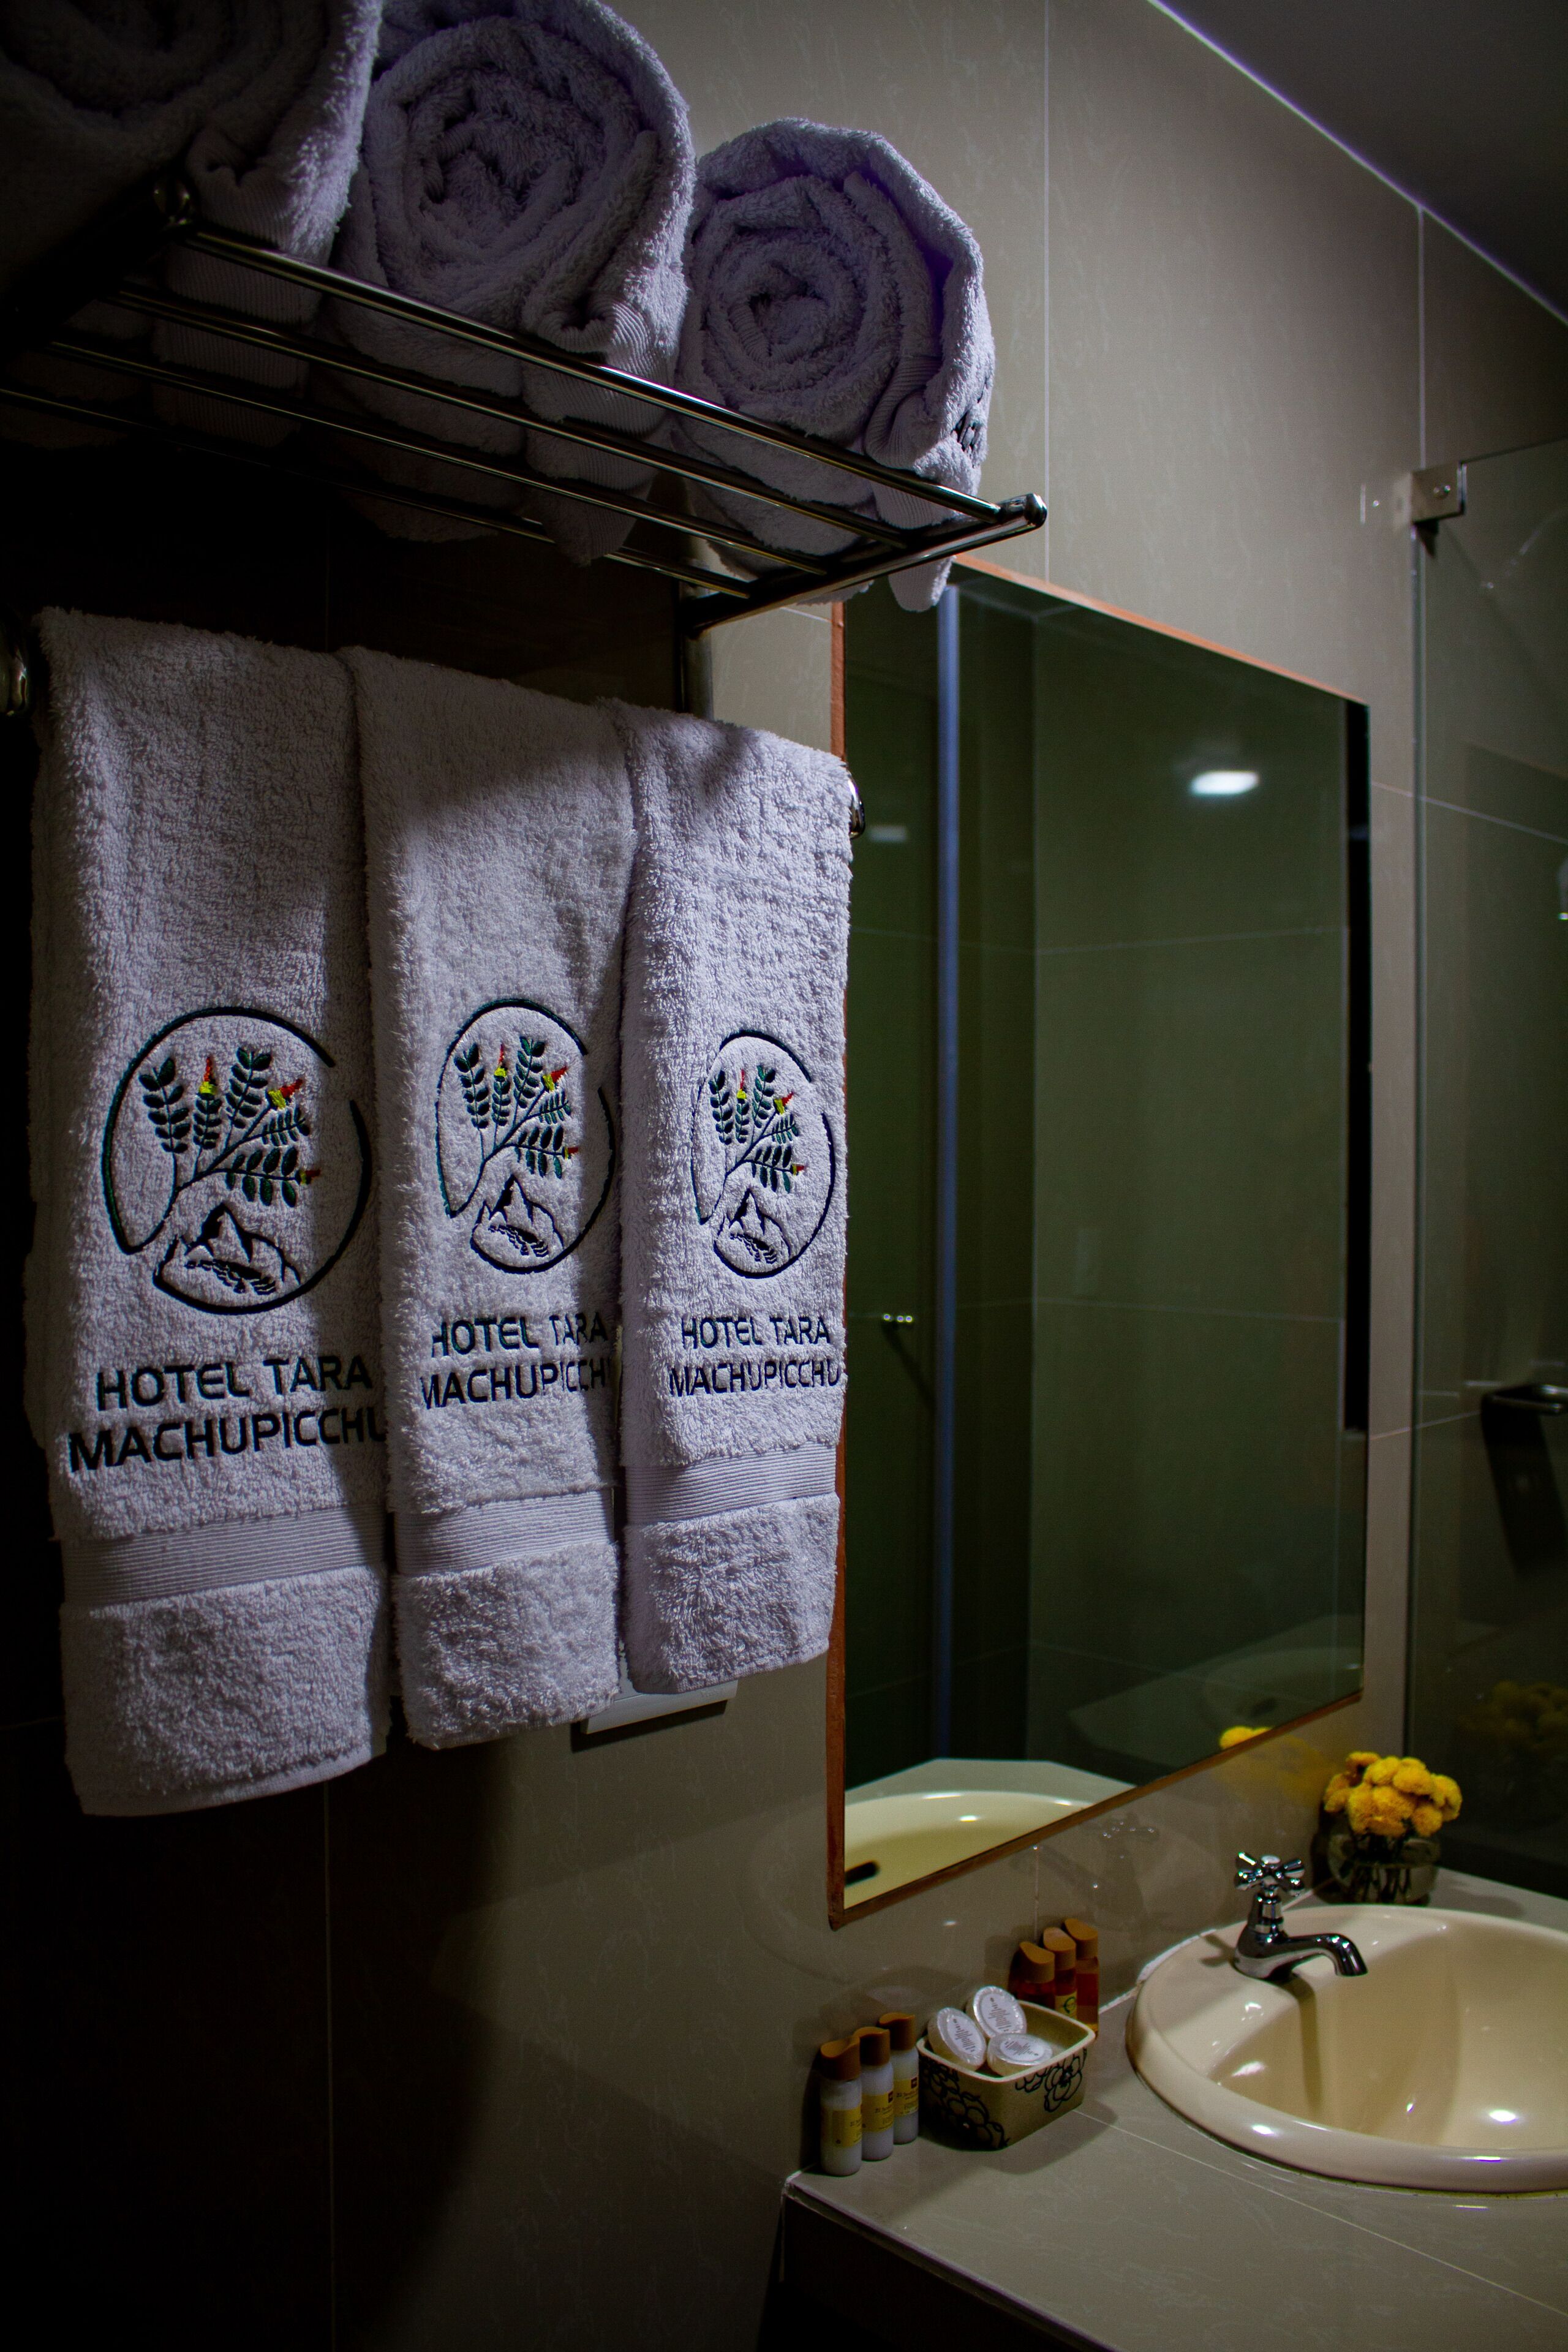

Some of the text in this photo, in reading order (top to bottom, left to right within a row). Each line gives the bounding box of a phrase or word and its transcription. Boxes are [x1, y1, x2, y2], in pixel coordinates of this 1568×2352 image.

[432, 1312, 608, 1357] HOTEL TARA
[683, 1316, 830, 1349] HOTEL TARA
[97, 1355, 372, 1411] HOTEL TARA
[421, 1357, 611, 1409] MACHUPICCH
[669, 1359, 839, 1396] MACHUPICCHU
